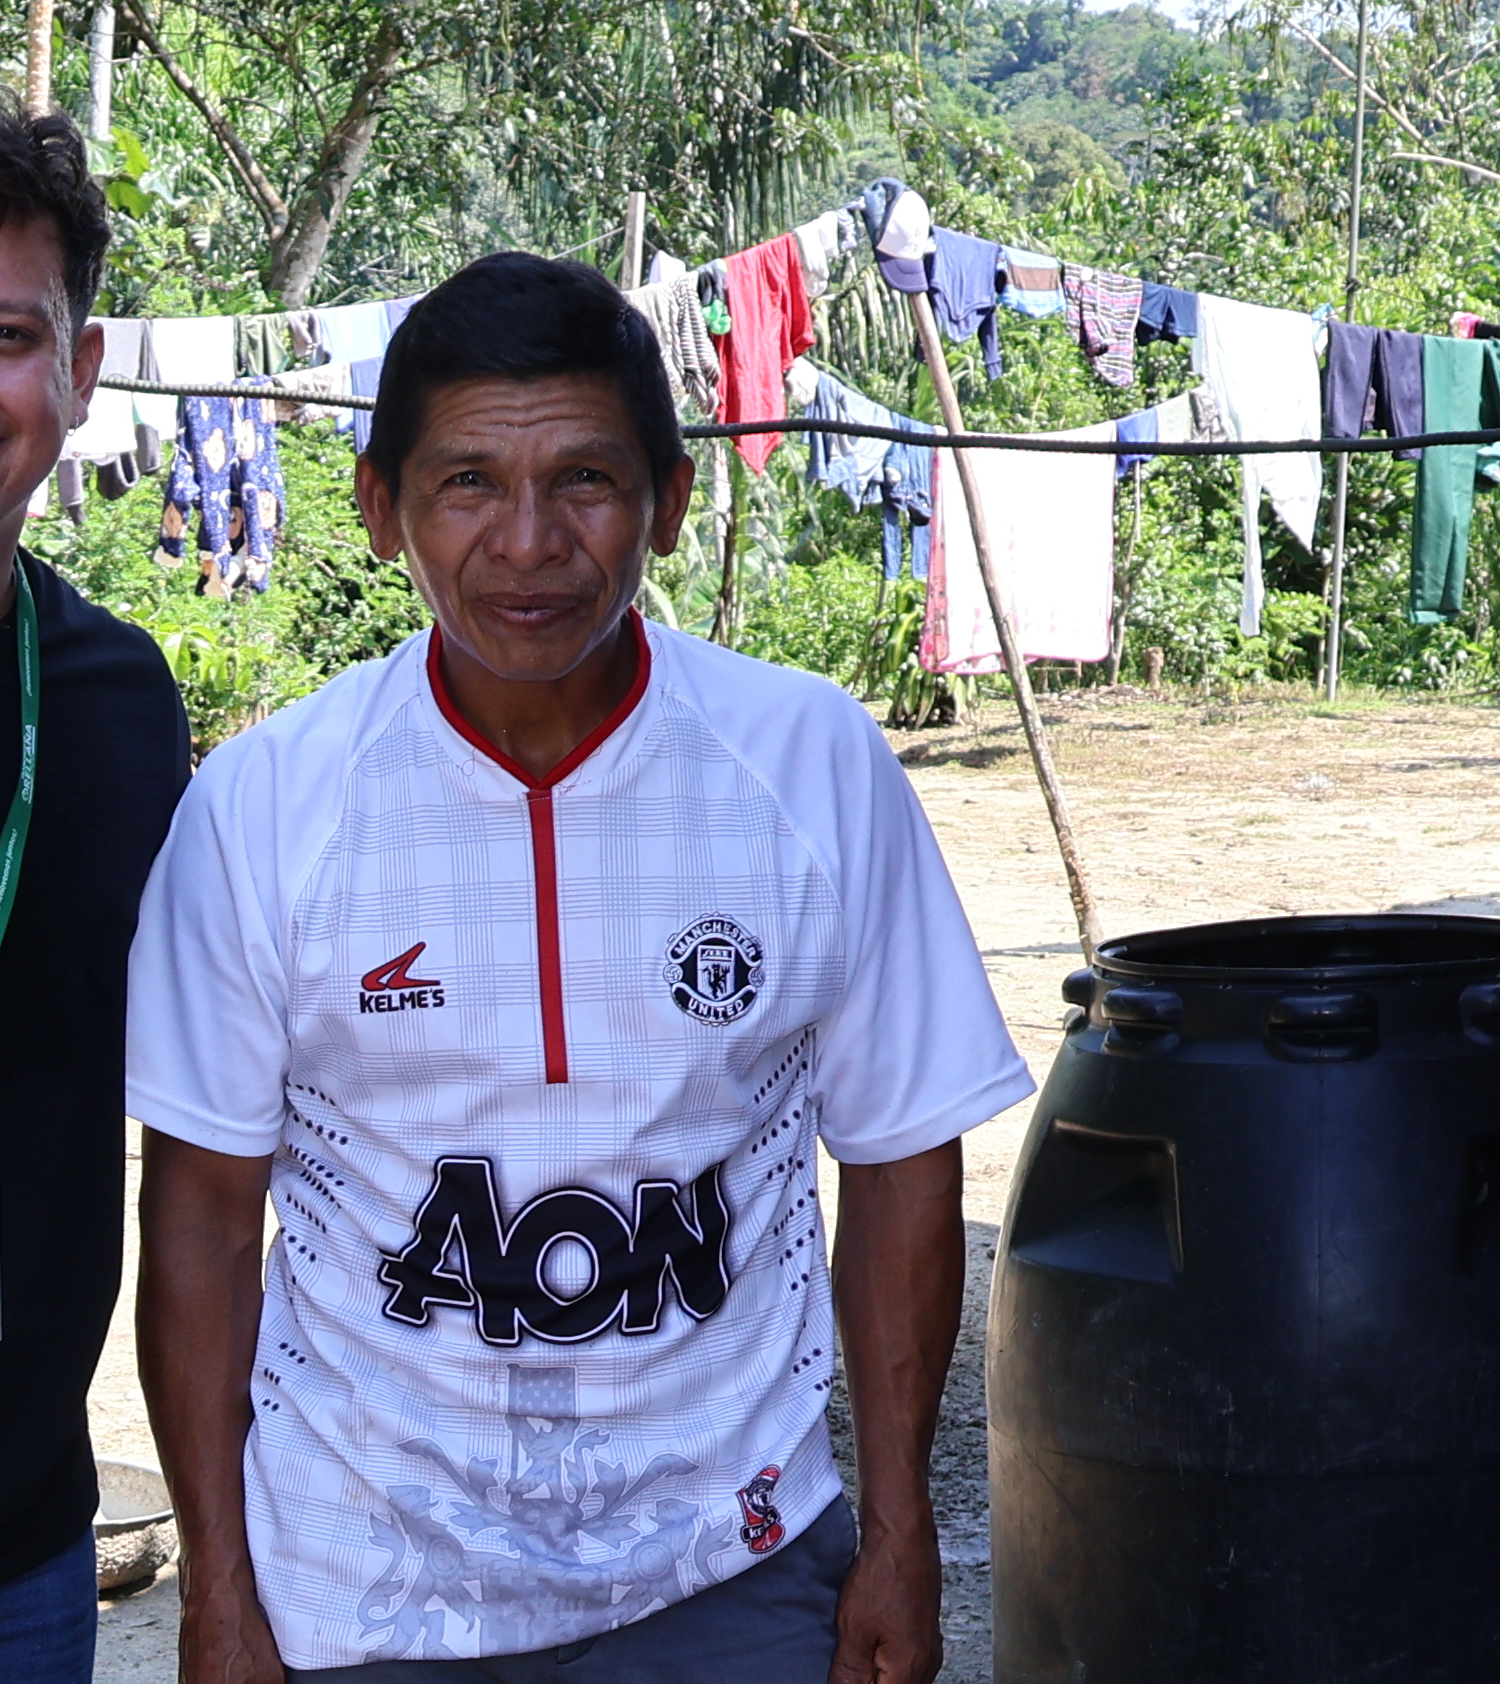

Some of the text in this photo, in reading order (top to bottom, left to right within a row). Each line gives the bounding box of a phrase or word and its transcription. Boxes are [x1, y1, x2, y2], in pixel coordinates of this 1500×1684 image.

[674, 921, 757, 959] MANCHESTER
[359, 988, 445, 1014] KELME'S
[688, 998, 744, 1018] UNITED
[378, 1156, 731, 1345] AON
